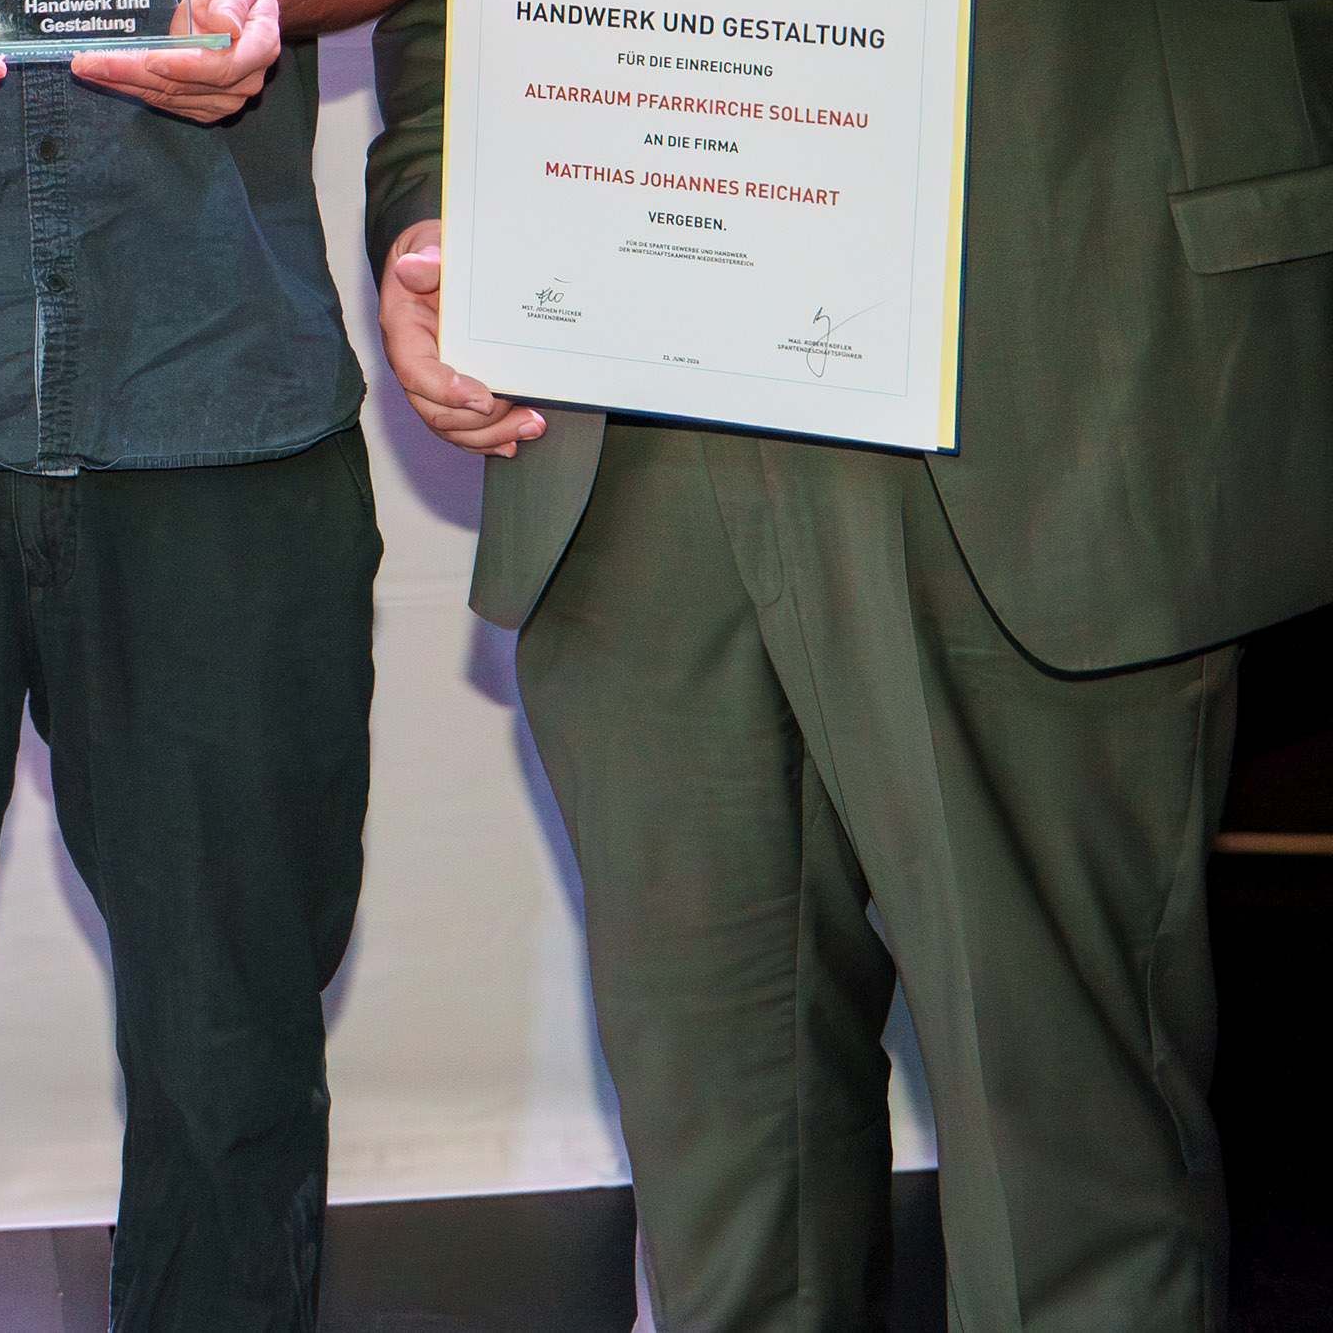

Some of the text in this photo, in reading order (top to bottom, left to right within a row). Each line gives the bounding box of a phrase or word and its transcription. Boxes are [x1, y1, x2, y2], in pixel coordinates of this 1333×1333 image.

[40, 16, 136, 33] Gestaltung
[517, 1, 885, 49] HANDWERK UND GESTALTUNG
[618, 51, 773, 77] FÜR DIE EINREICHUNG
[525, 83, 869, 129] ALTARRAUM PFARRKIRCHE SOLLENAU
[644, 133, 739, 154] AN DIE FIRMA
[545, 161, 840, 206] MATTHIAS JOHANNES REICHART
[648, 211, 727, 231] VERGEBEN.
[626, 239, 638, 247] FÜR
[649, 242, 670, 251] SPARTE
[671, 244, 699, 254] GEWERBE
[714, 249, 748, 258] HANDWERK
[632, 247, 696, 261] WIRTSCHAFTSKAMMER
